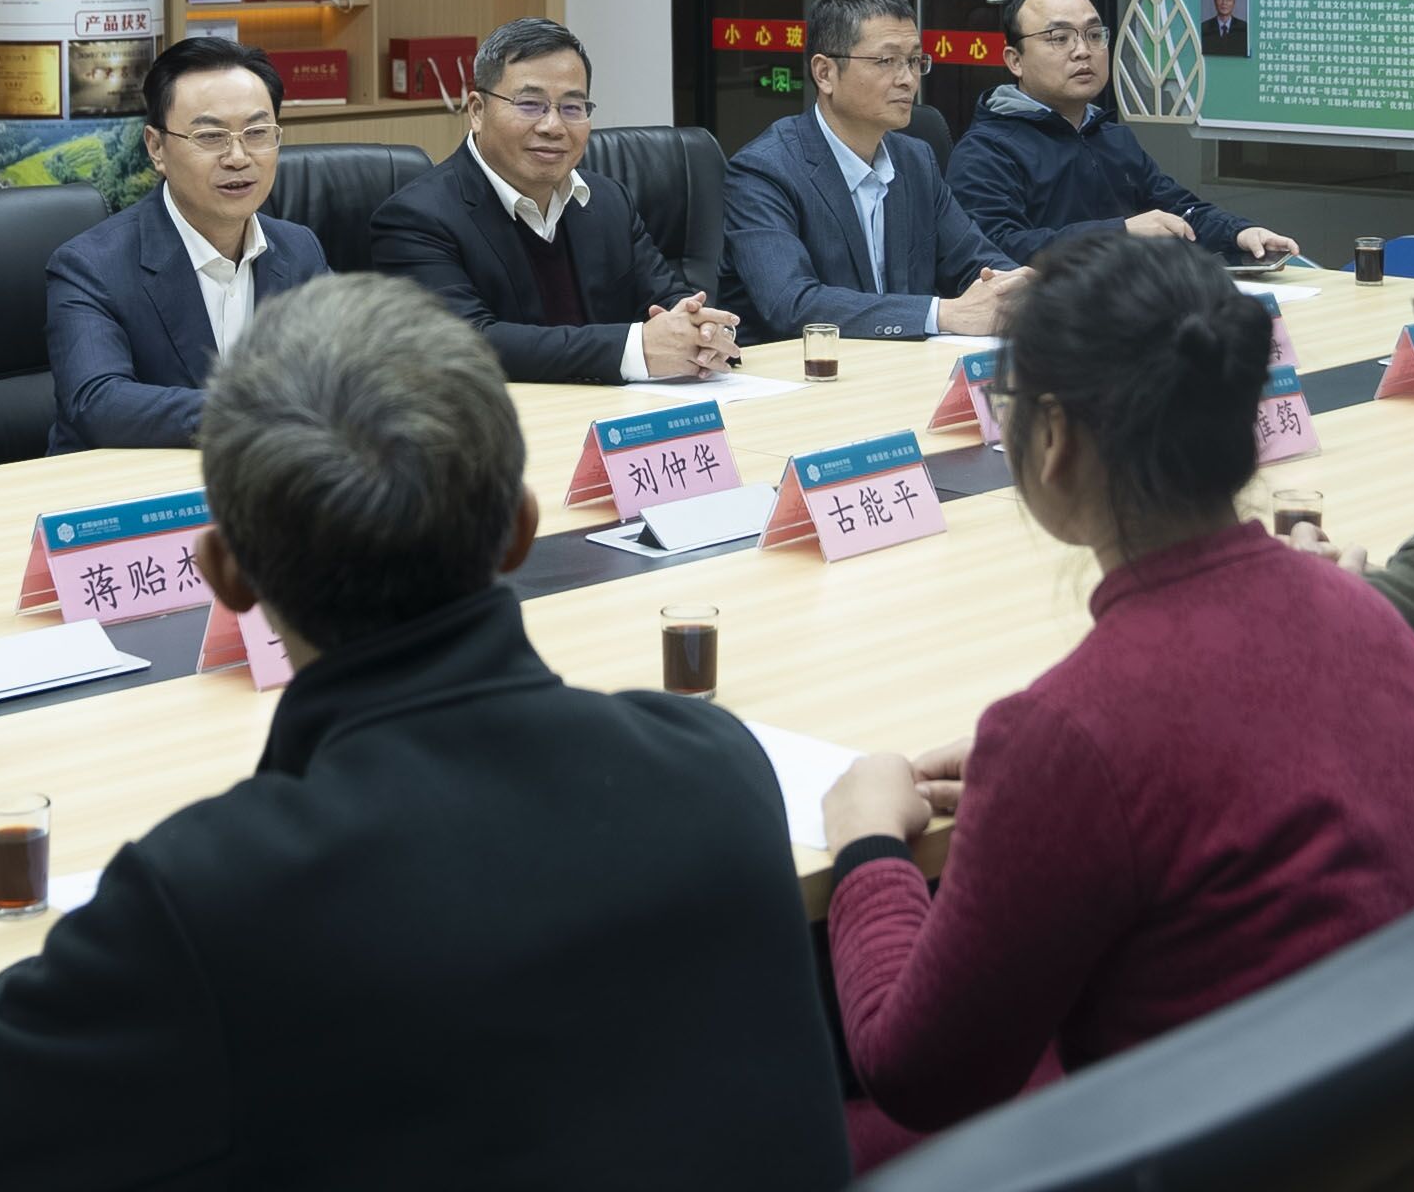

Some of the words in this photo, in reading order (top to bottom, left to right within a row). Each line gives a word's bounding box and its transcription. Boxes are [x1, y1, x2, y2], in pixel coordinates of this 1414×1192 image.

[85, 13, 147, 33] 产品获奖
[725, 24, 805, 48] 小心玻
[934, 35, 988, 60] 小心
[628, 443, 720, 497] 刘仲华
[827, 479, 919, 534] 古能平
[80, 546, 202, 613] 蒋贻杰
